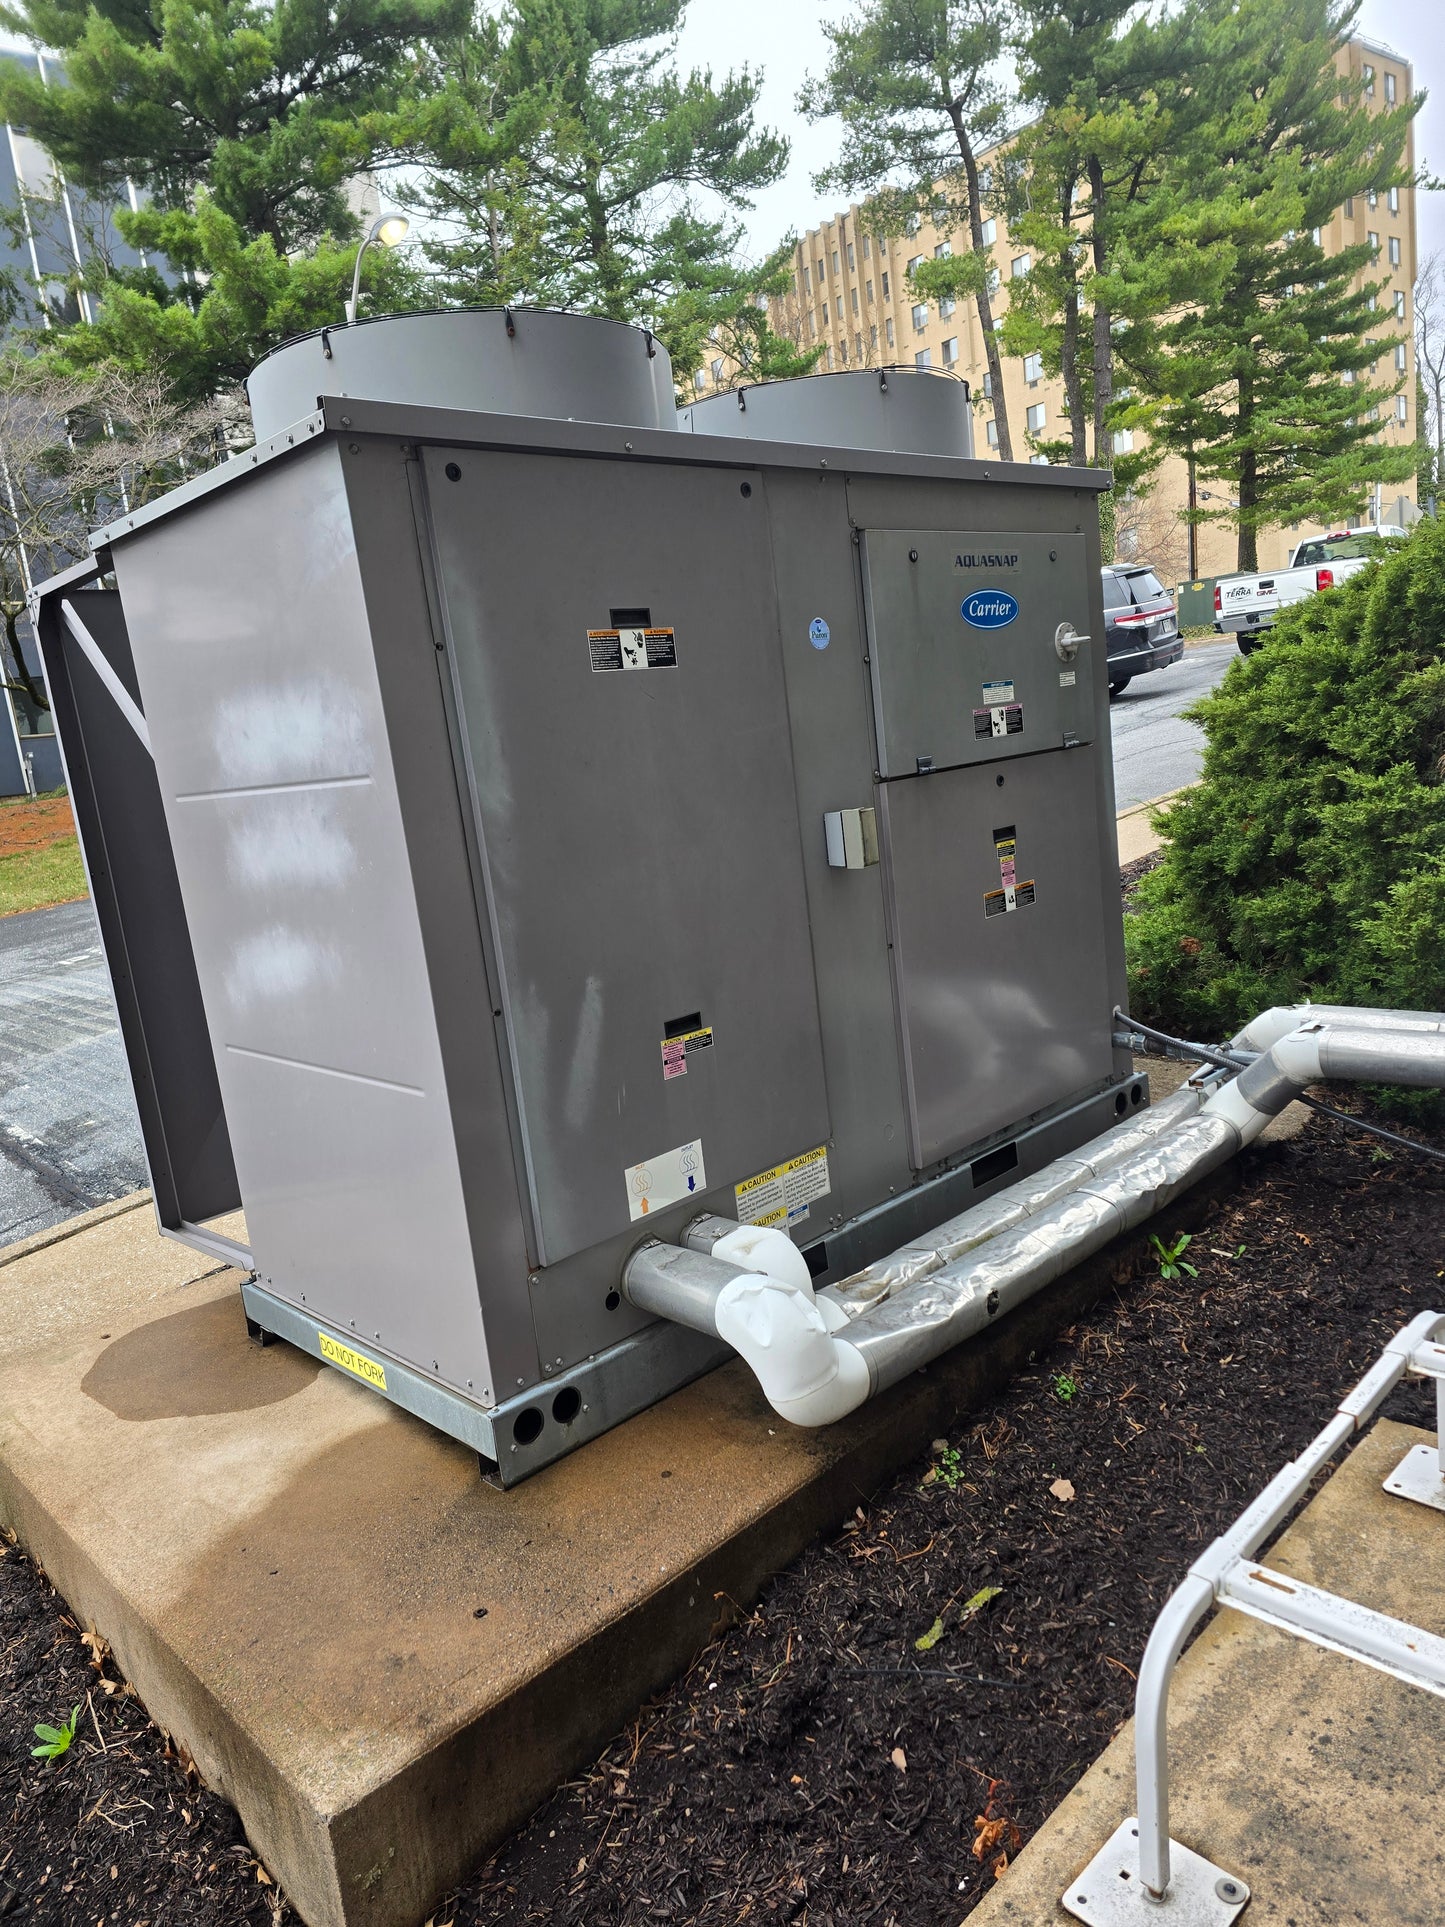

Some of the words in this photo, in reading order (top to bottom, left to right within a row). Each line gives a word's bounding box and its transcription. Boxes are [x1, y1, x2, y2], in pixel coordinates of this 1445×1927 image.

[955, 555, 1018, 569] AQUASNAP
[1226, 588, 1251, 598] TERRA
[1256, 588, 1278, 597] GMC
[969, 600, 1011, 617] Carrier
[794, 1149, 821, 1168] CAUTION
[747, 1170, 776, 1188] CAUTION
[320, 1337, 334, 1355] DO
[336, 1346, 355, 1368] NOT
[358, 1358, 386, 1385] FORK
